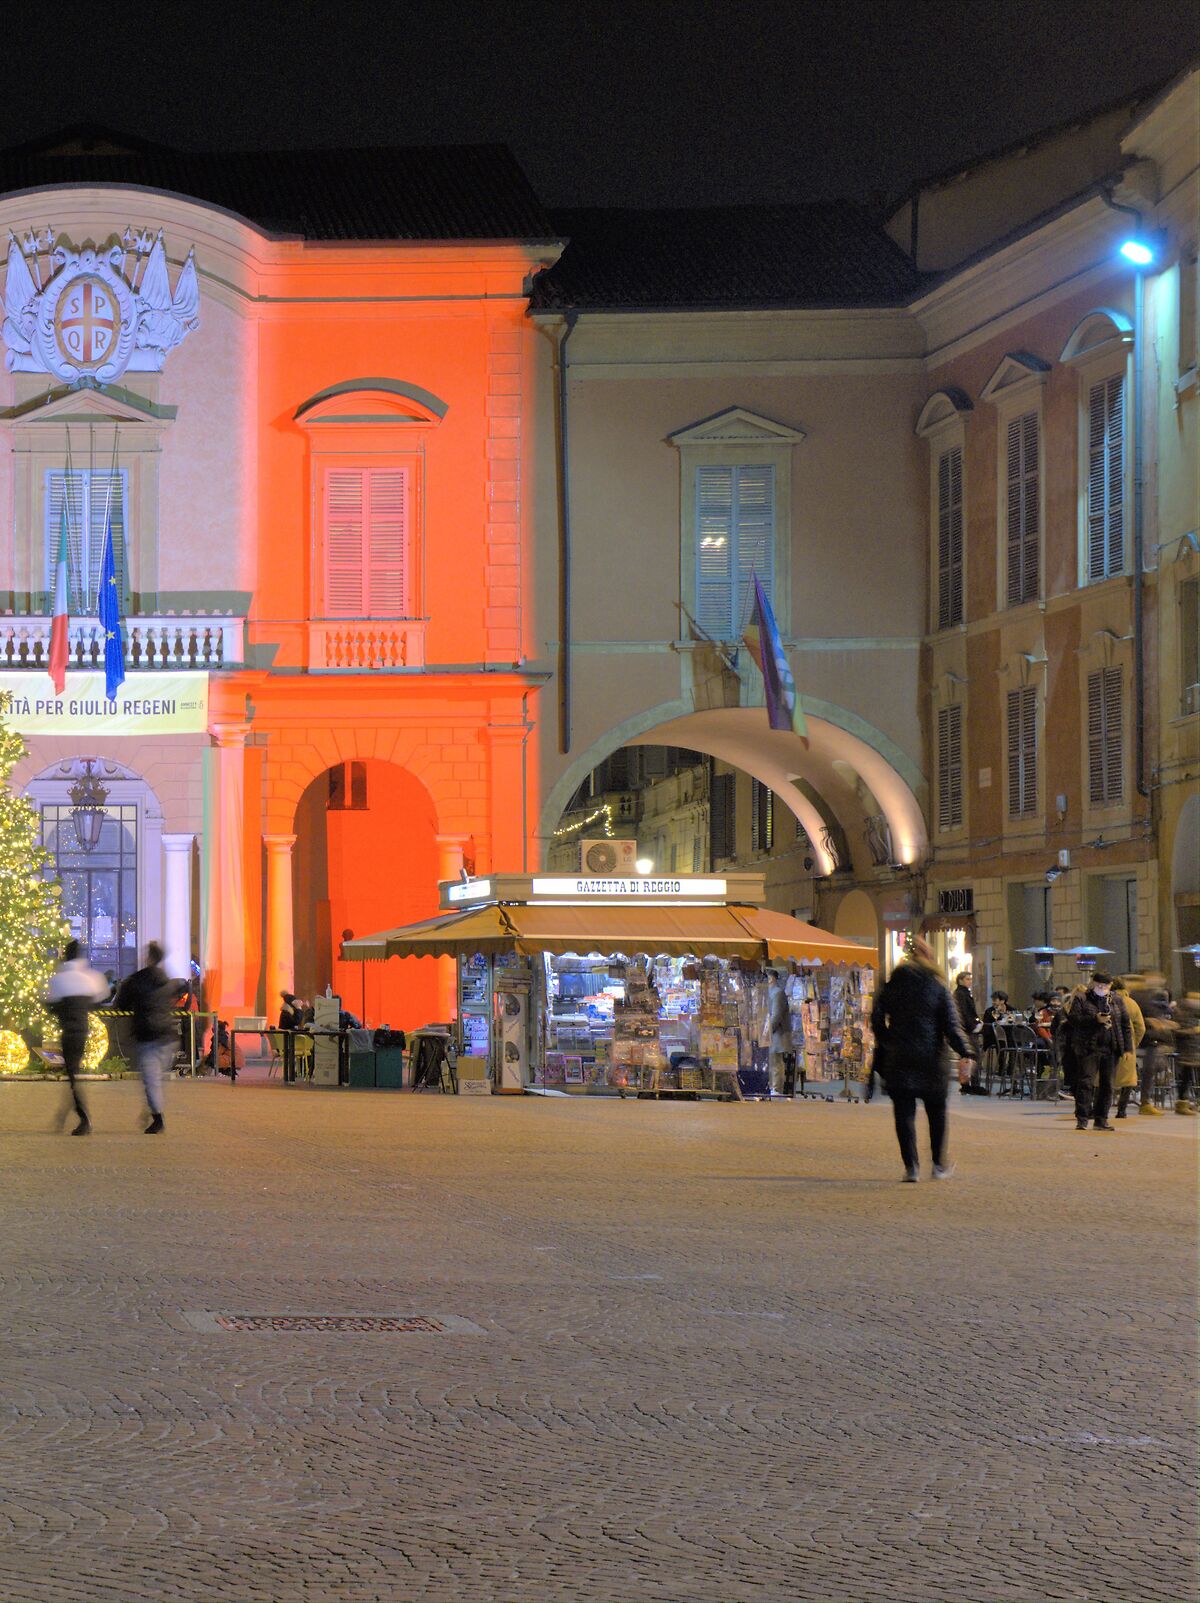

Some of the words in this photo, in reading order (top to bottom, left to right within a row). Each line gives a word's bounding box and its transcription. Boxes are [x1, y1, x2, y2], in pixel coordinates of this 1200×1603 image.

[71, 297, 79, 314] S
[95, 296, 105, 314] P
[68, 331, 80, 352] Q
[95, 331, 106, 349] R
[36, 700, 63, 715] PER
[69, 699, 118, 715] GIULIO
[123, 699, 176, 715] REGENI
[576, 881, 627, 893] GAZZETTA
[630, 881, 639, 892] DI
[643, 881, 681, 893] REGGIO
